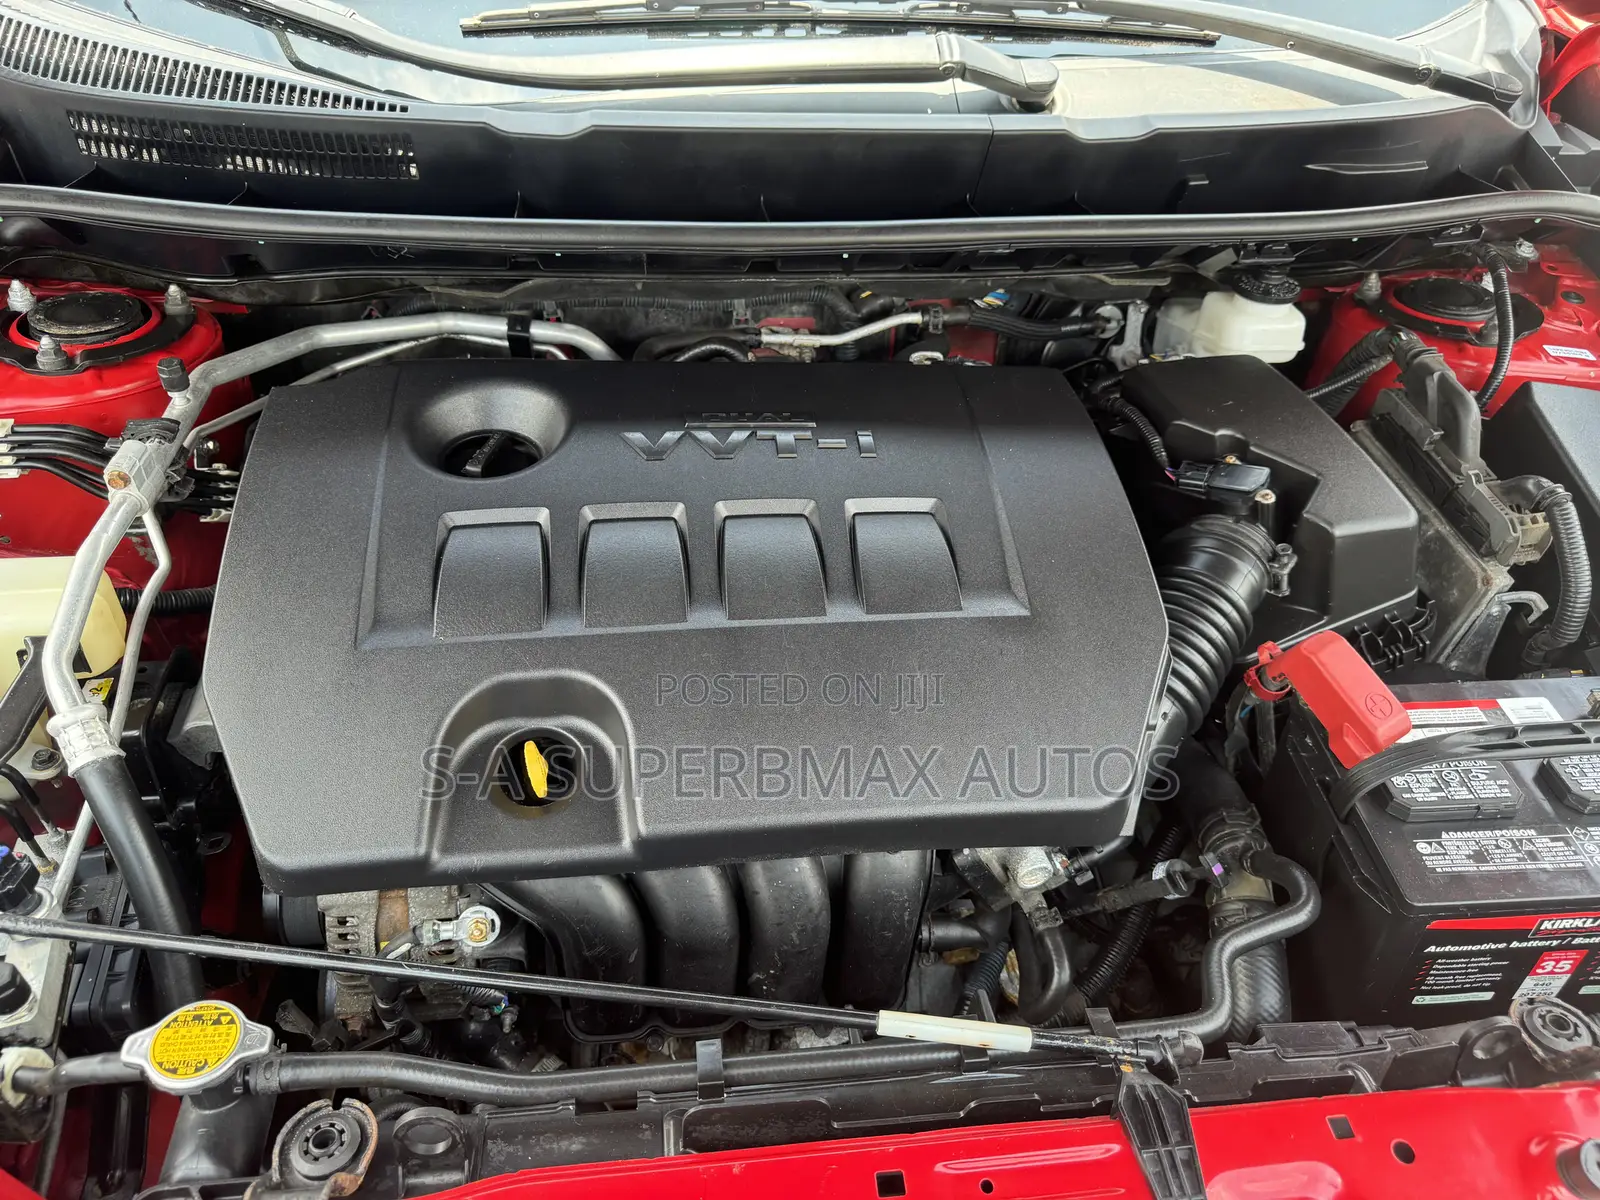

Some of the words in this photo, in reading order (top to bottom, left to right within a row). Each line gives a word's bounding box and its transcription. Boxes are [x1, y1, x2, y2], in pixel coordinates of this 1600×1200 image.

[1448, 829, 1537, 838] DANGER/POISON
[1423, 942, 1507, 952] Automotive
[1509, 940, 1562, 948] battery
[1536, 960, 1574, 974] 35
[169, 1019, 213, 1028] ATTENTION
[162, 1058, 205, 1068] CAUTION
